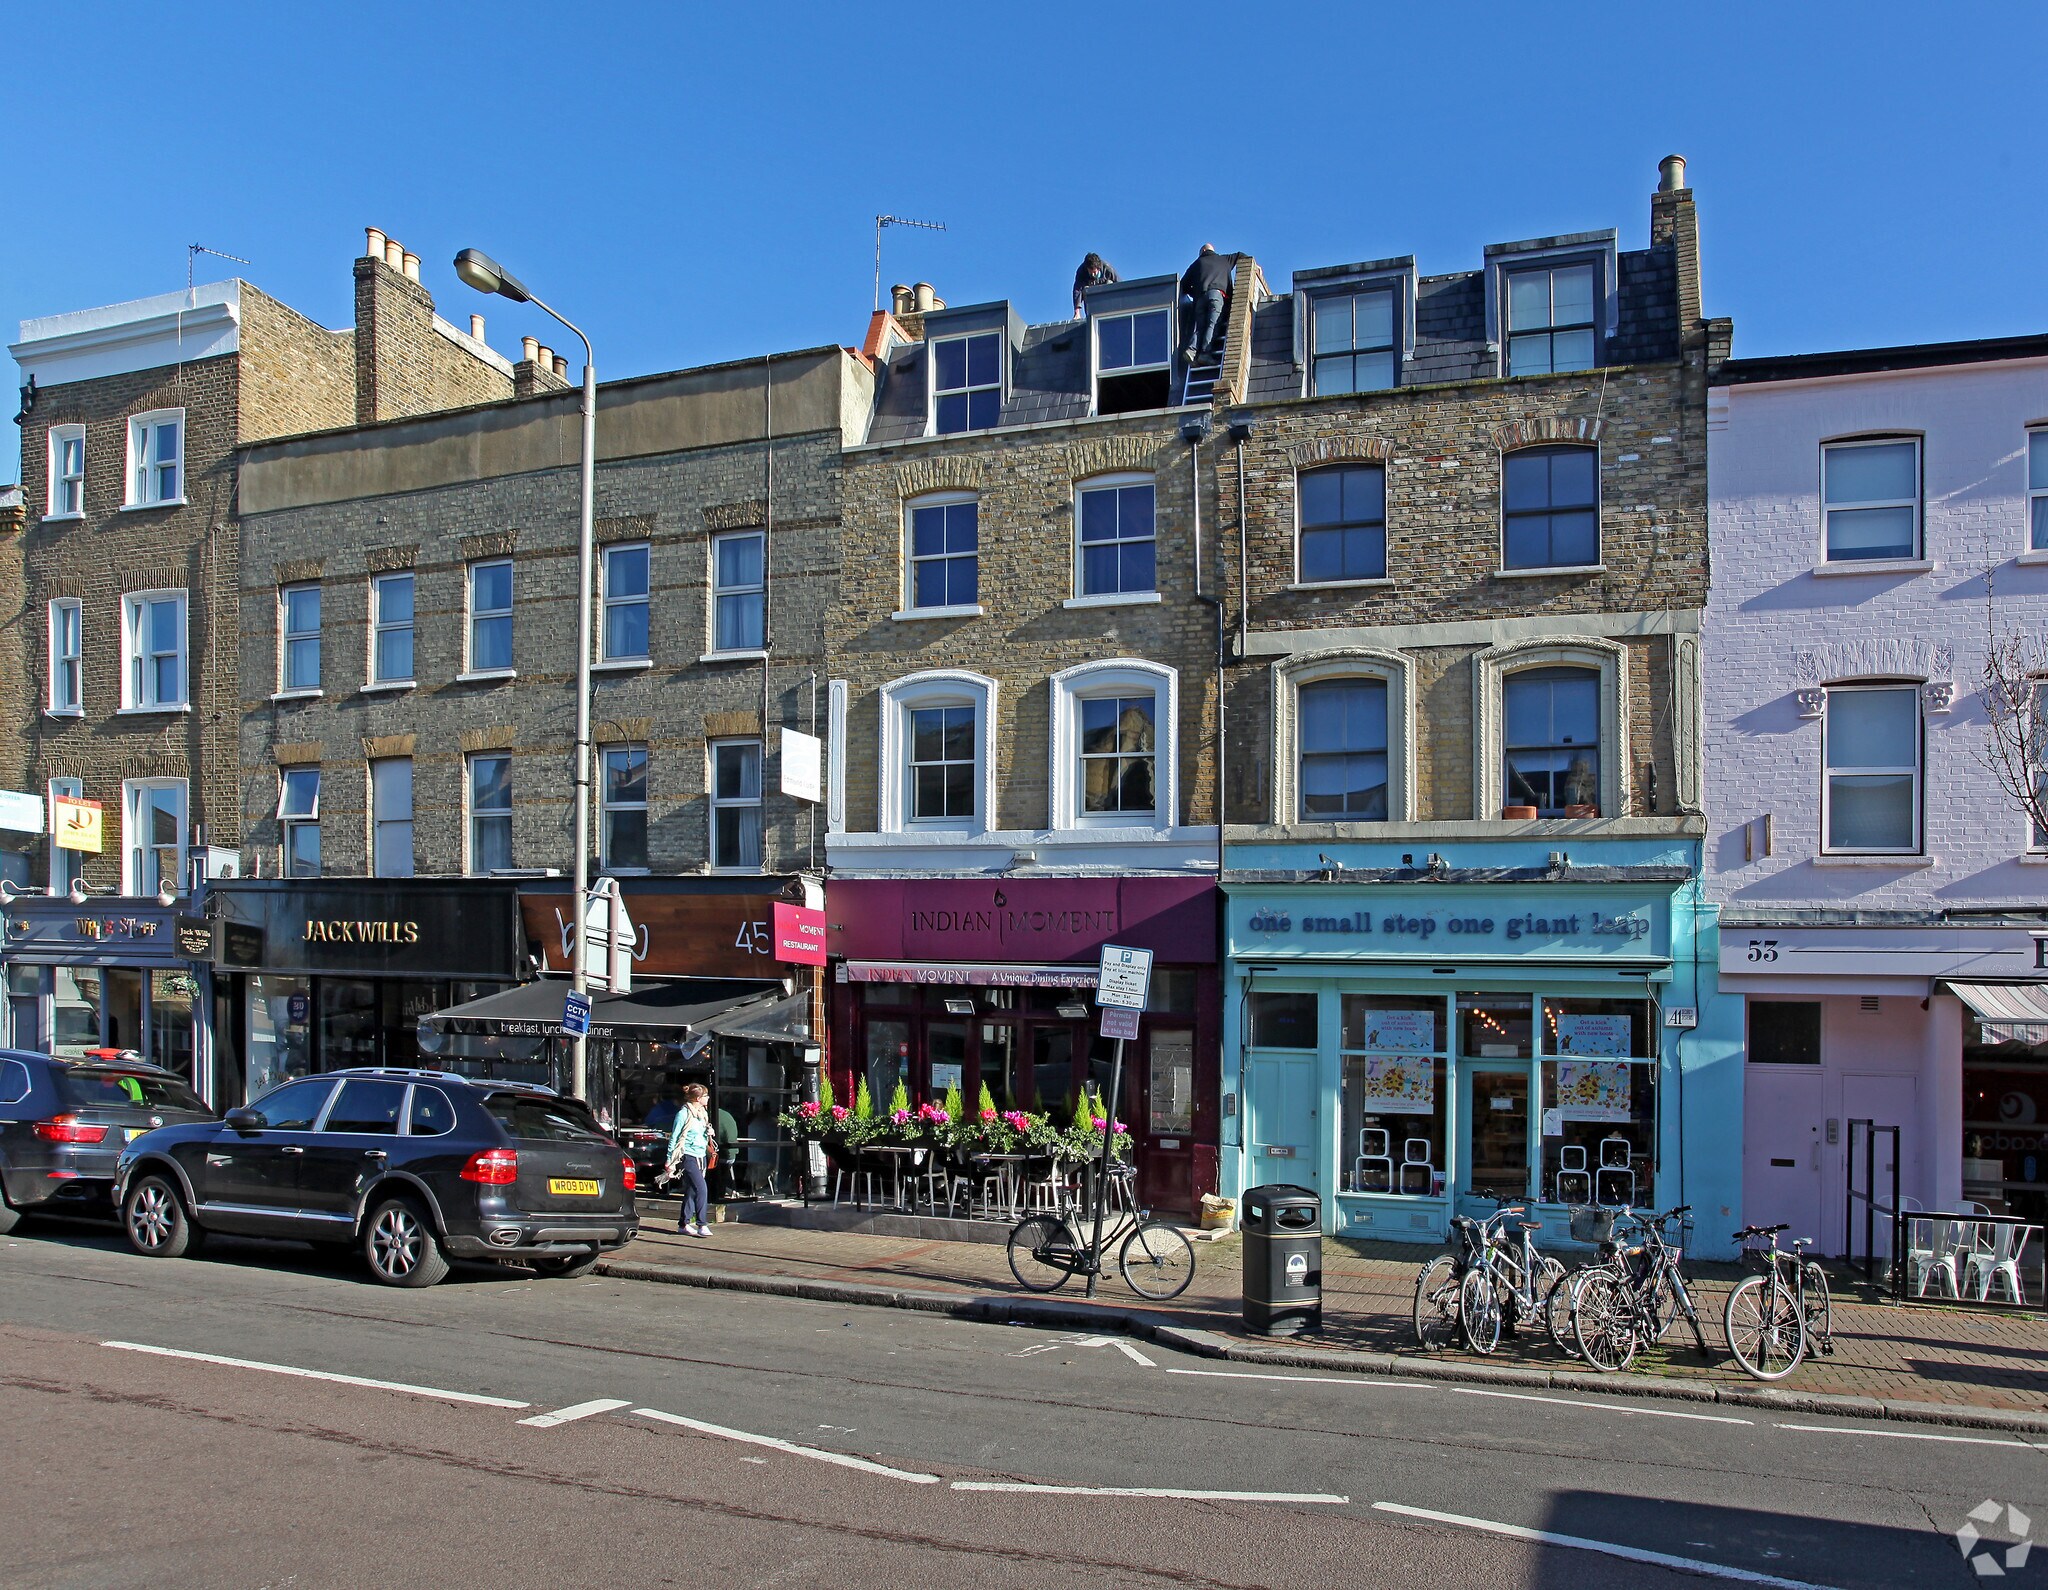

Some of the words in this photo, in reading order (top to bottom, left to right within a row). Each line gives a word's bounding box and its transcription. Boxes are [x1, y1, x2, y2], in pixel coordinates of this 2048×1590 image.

[799, 924, 824, 936] MOMENT
[912, 911, 992, 932] INDIAN
[1008, 911, 1114, 934] MOMENT
[1248, 916, 1292, 932] one
[1302, 912, 1372, 933] small
[1383, 913, 1436, 940] step
[1448, 917, 1495, 934] one
[1506, 912, 1580, 940] giant
[1592, 912, 1650, 940] leap
[180, 928, 194, 936] Jack
[194, 929, 211, 938] Wills
[302, 920, 354, 942] JACK
[356, 920, 418, 943] WILLS
[735, 921, 768, 954] 45
[783, 940, 818, 952] RESTAURANT
[1748, 940, 1778, 962] 53
[868, 968, 913, 981] INDIAN
[917, 969, 971, 983] MOMENT
[991, 972, 1000, 981] A
[1000, 972, 1029, 984] Unique
[1031, 973, 1059, 985] Dining
[1061, 973, 1099, 985] Experienc
[567, 1004, 587, 1017] CCTV
[1668, 1009, 1682, 1024] A1
[500, 1022, 540, 1034] breakfast,
[554, 1181, 578, 1191] WR09
